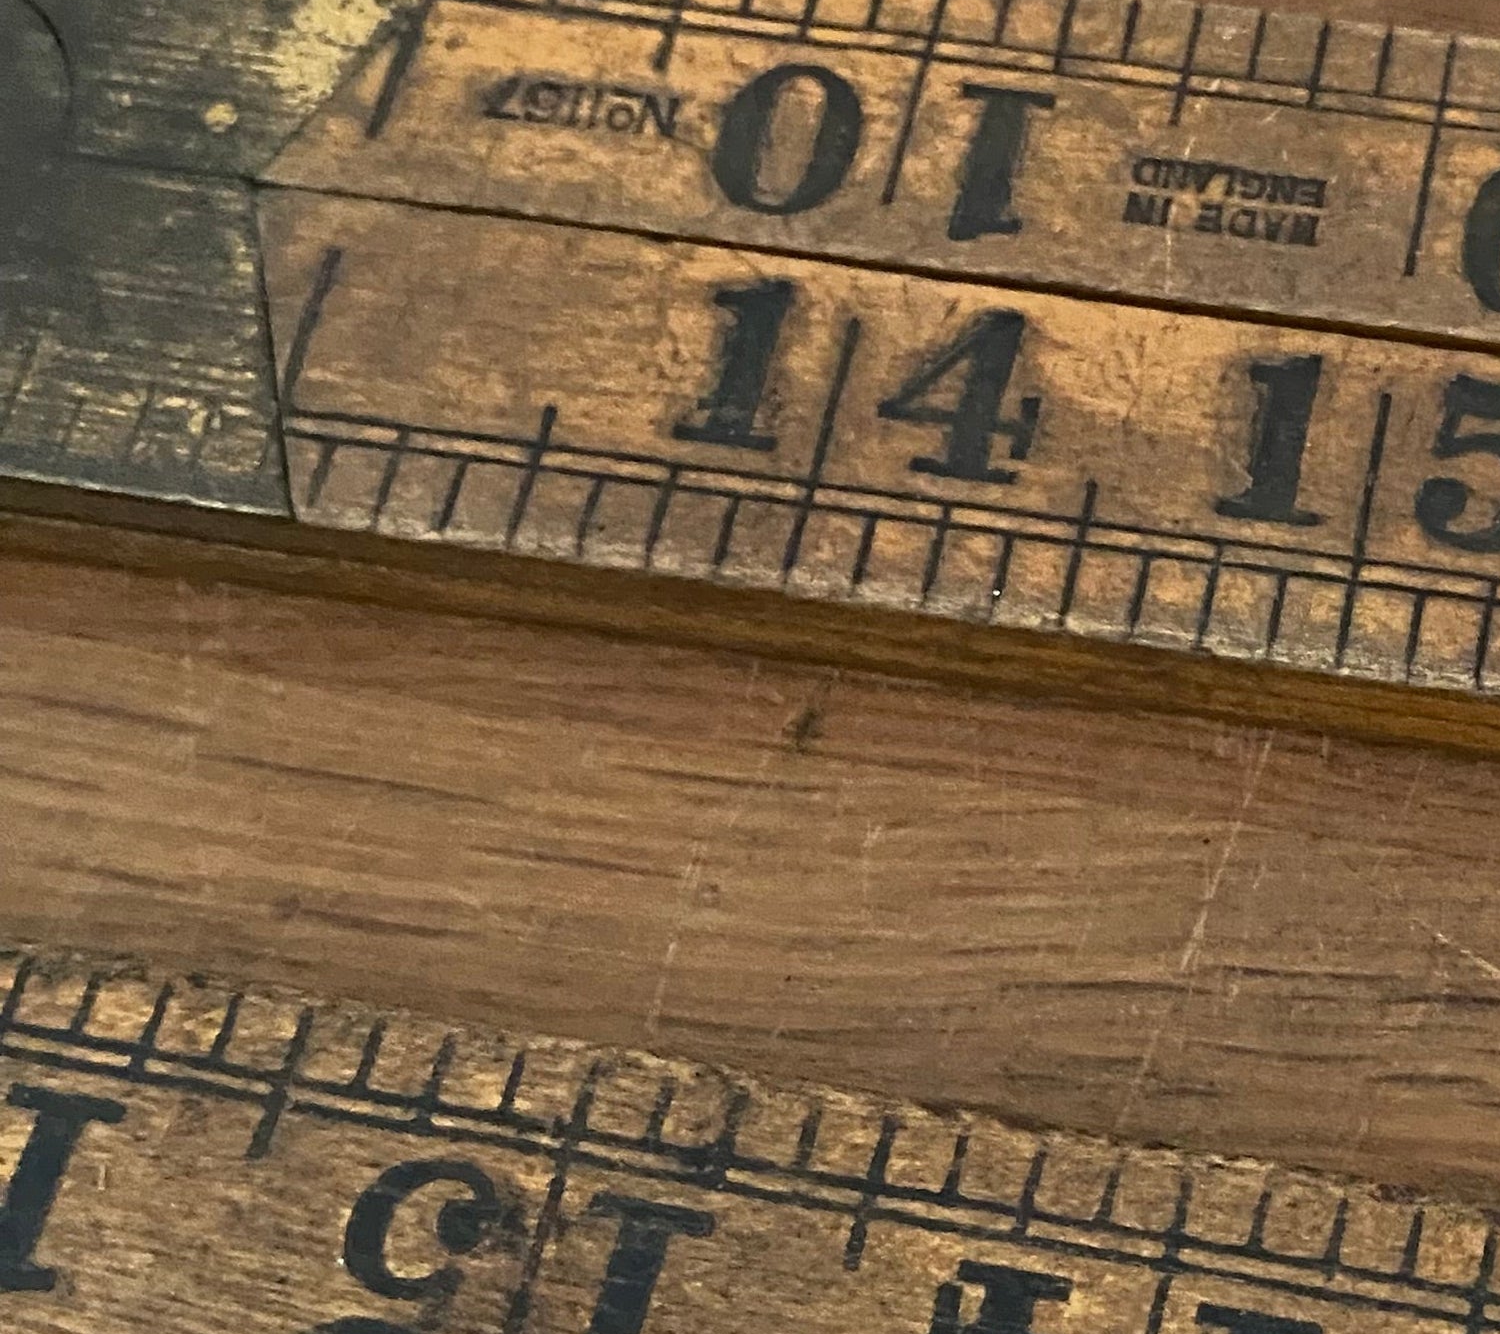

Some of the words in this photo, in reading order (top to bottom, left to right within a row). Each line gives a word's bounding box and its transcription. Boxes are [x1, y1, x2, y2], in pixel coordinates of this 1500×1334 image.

[710, 63, 1055, 240] 10
[1132, 158, 1327, 208] ENGLAND
[1122, 191, 1173, 227] IN
[1195, 204, 1320, 246] MADE
